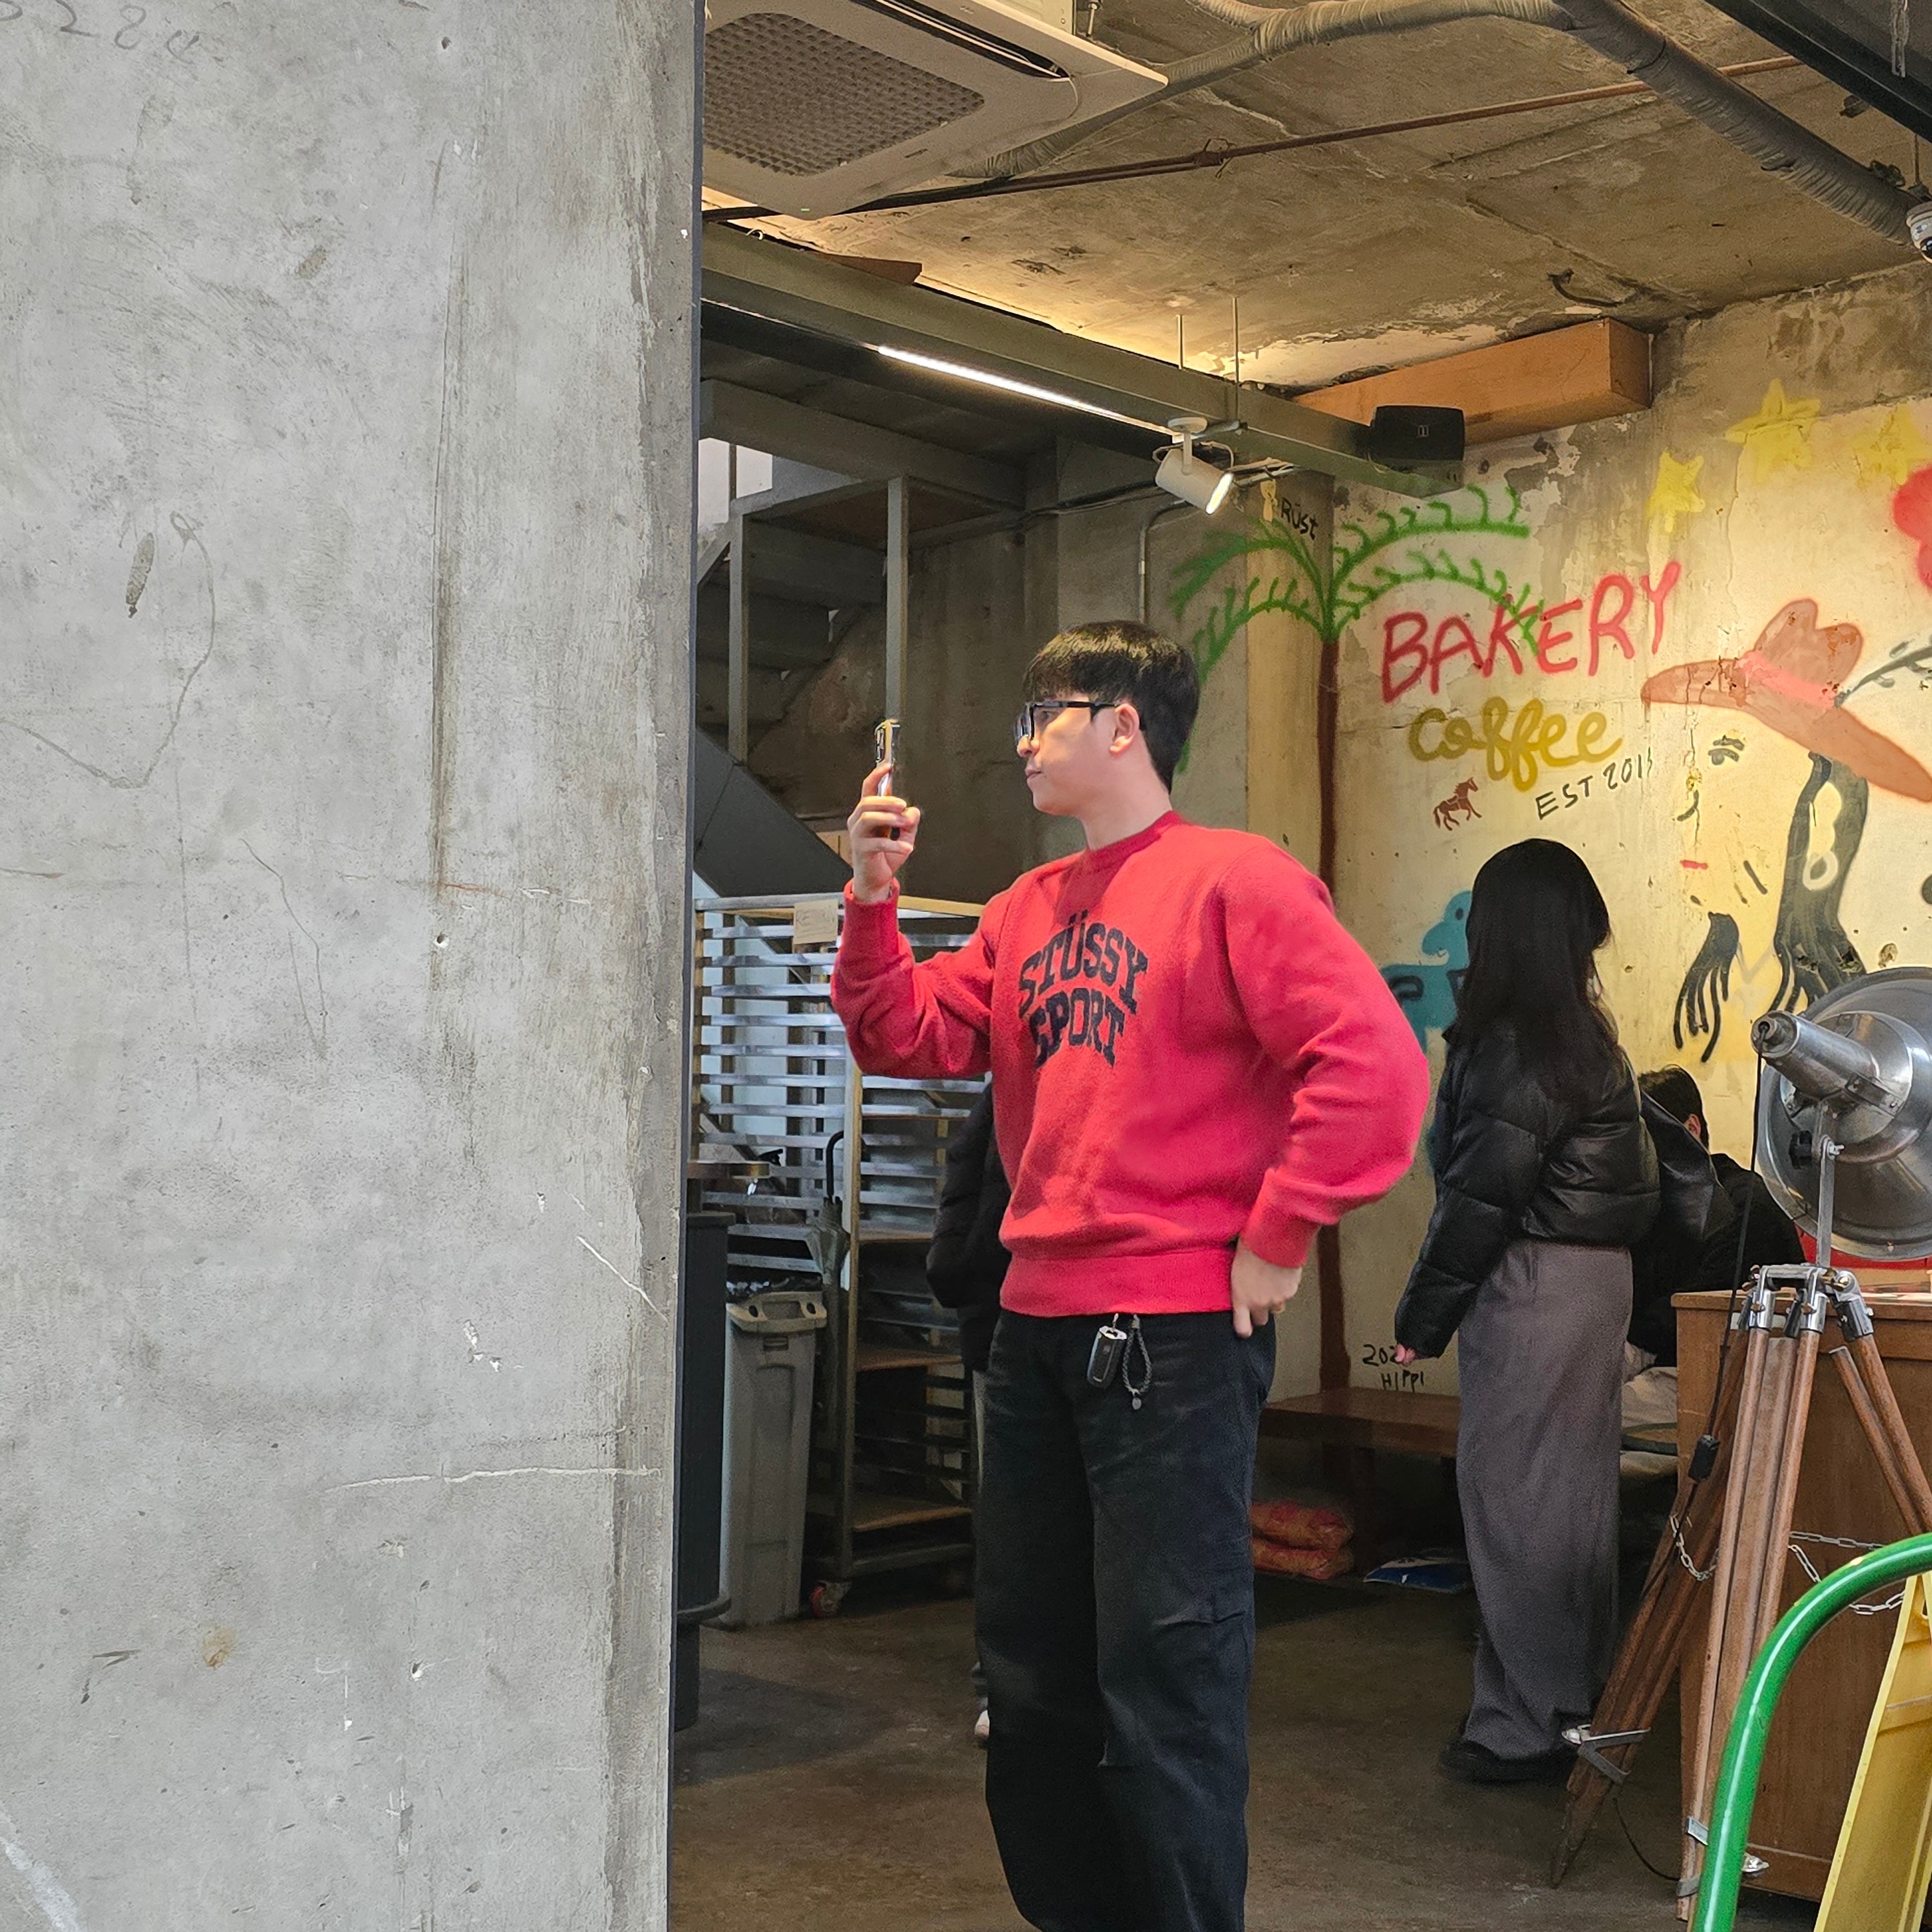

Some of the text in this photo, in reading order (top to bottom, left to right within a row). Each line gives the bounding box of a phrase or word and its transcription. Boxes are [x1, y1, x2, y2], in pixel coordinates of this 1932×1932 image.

[1381, 558, 1682, 703] BAKERY
[1535, 775, 1593, 820] EST
[1018, 909, 1148, 1019] STÜSSY
[1028, 987, 1126, 1070] SPORT
